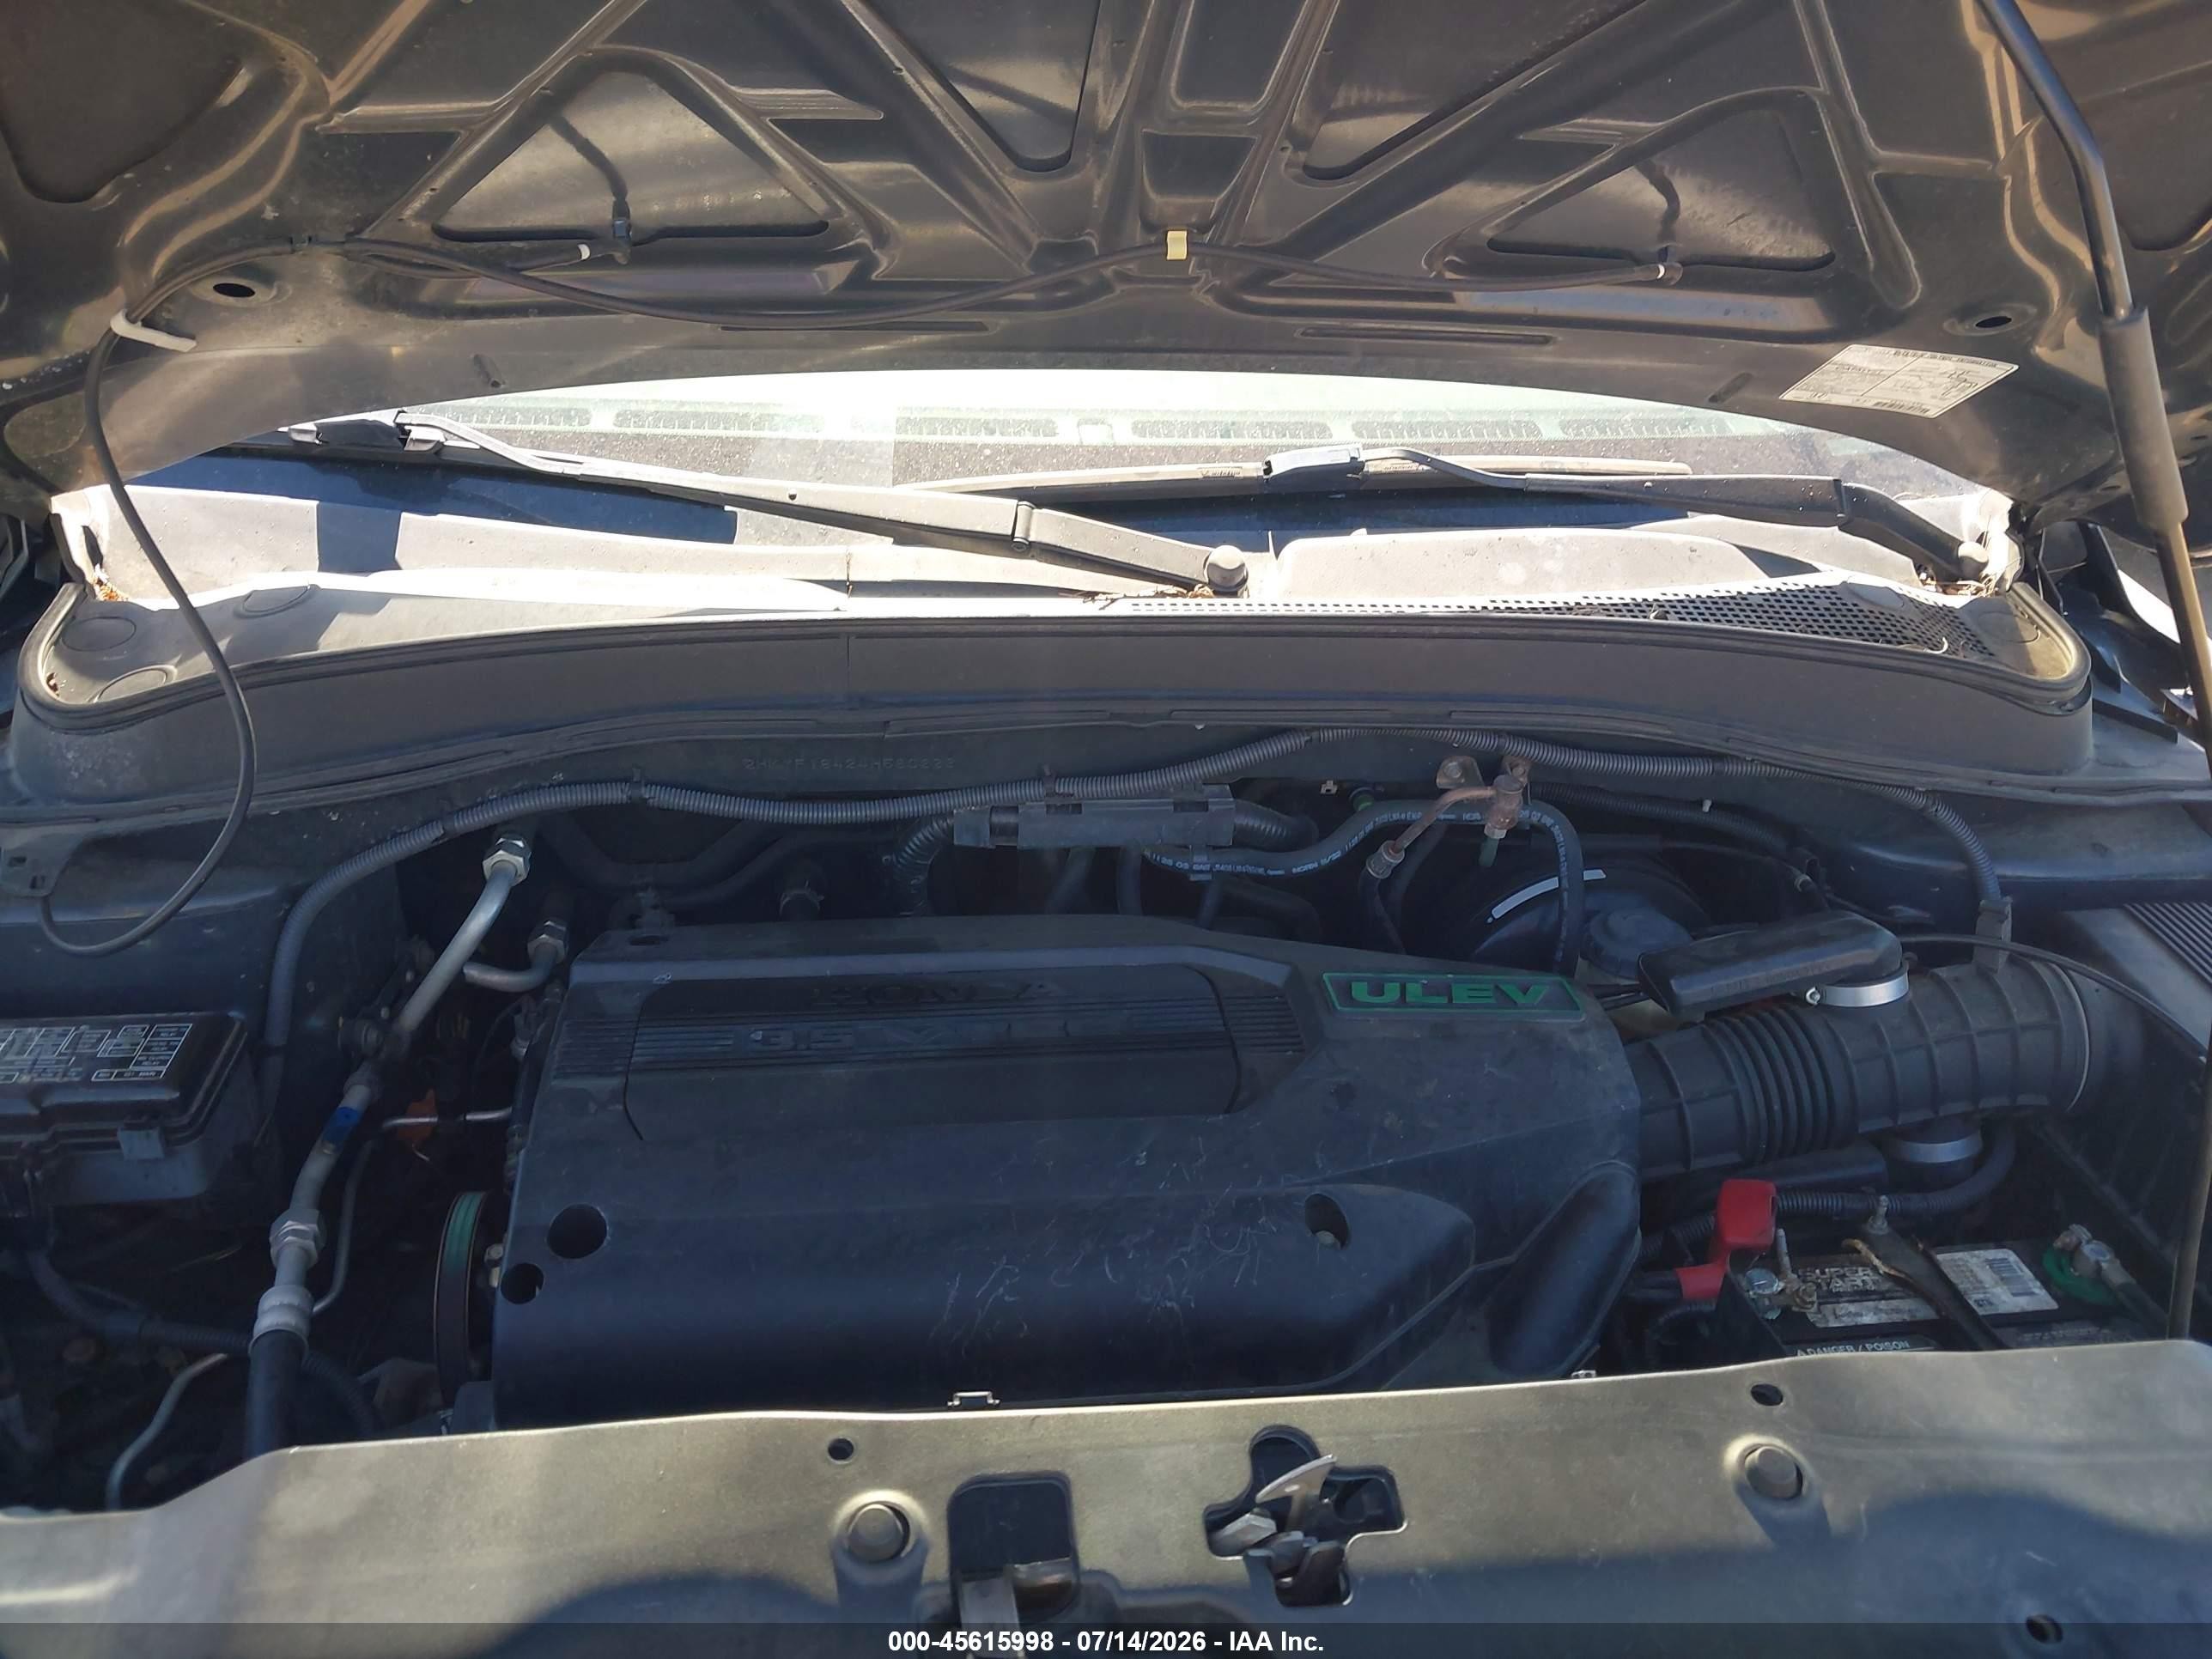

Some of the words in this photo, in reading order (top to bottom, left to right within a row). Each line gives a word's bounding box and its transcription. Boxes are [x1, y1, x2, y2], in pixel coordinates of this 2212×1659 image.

[1351, 981, 1549, 1005] ULEV
[1797, 1267, 1874, 1280] SUPER
[1864, 1340, 1911, 1352] POISON
